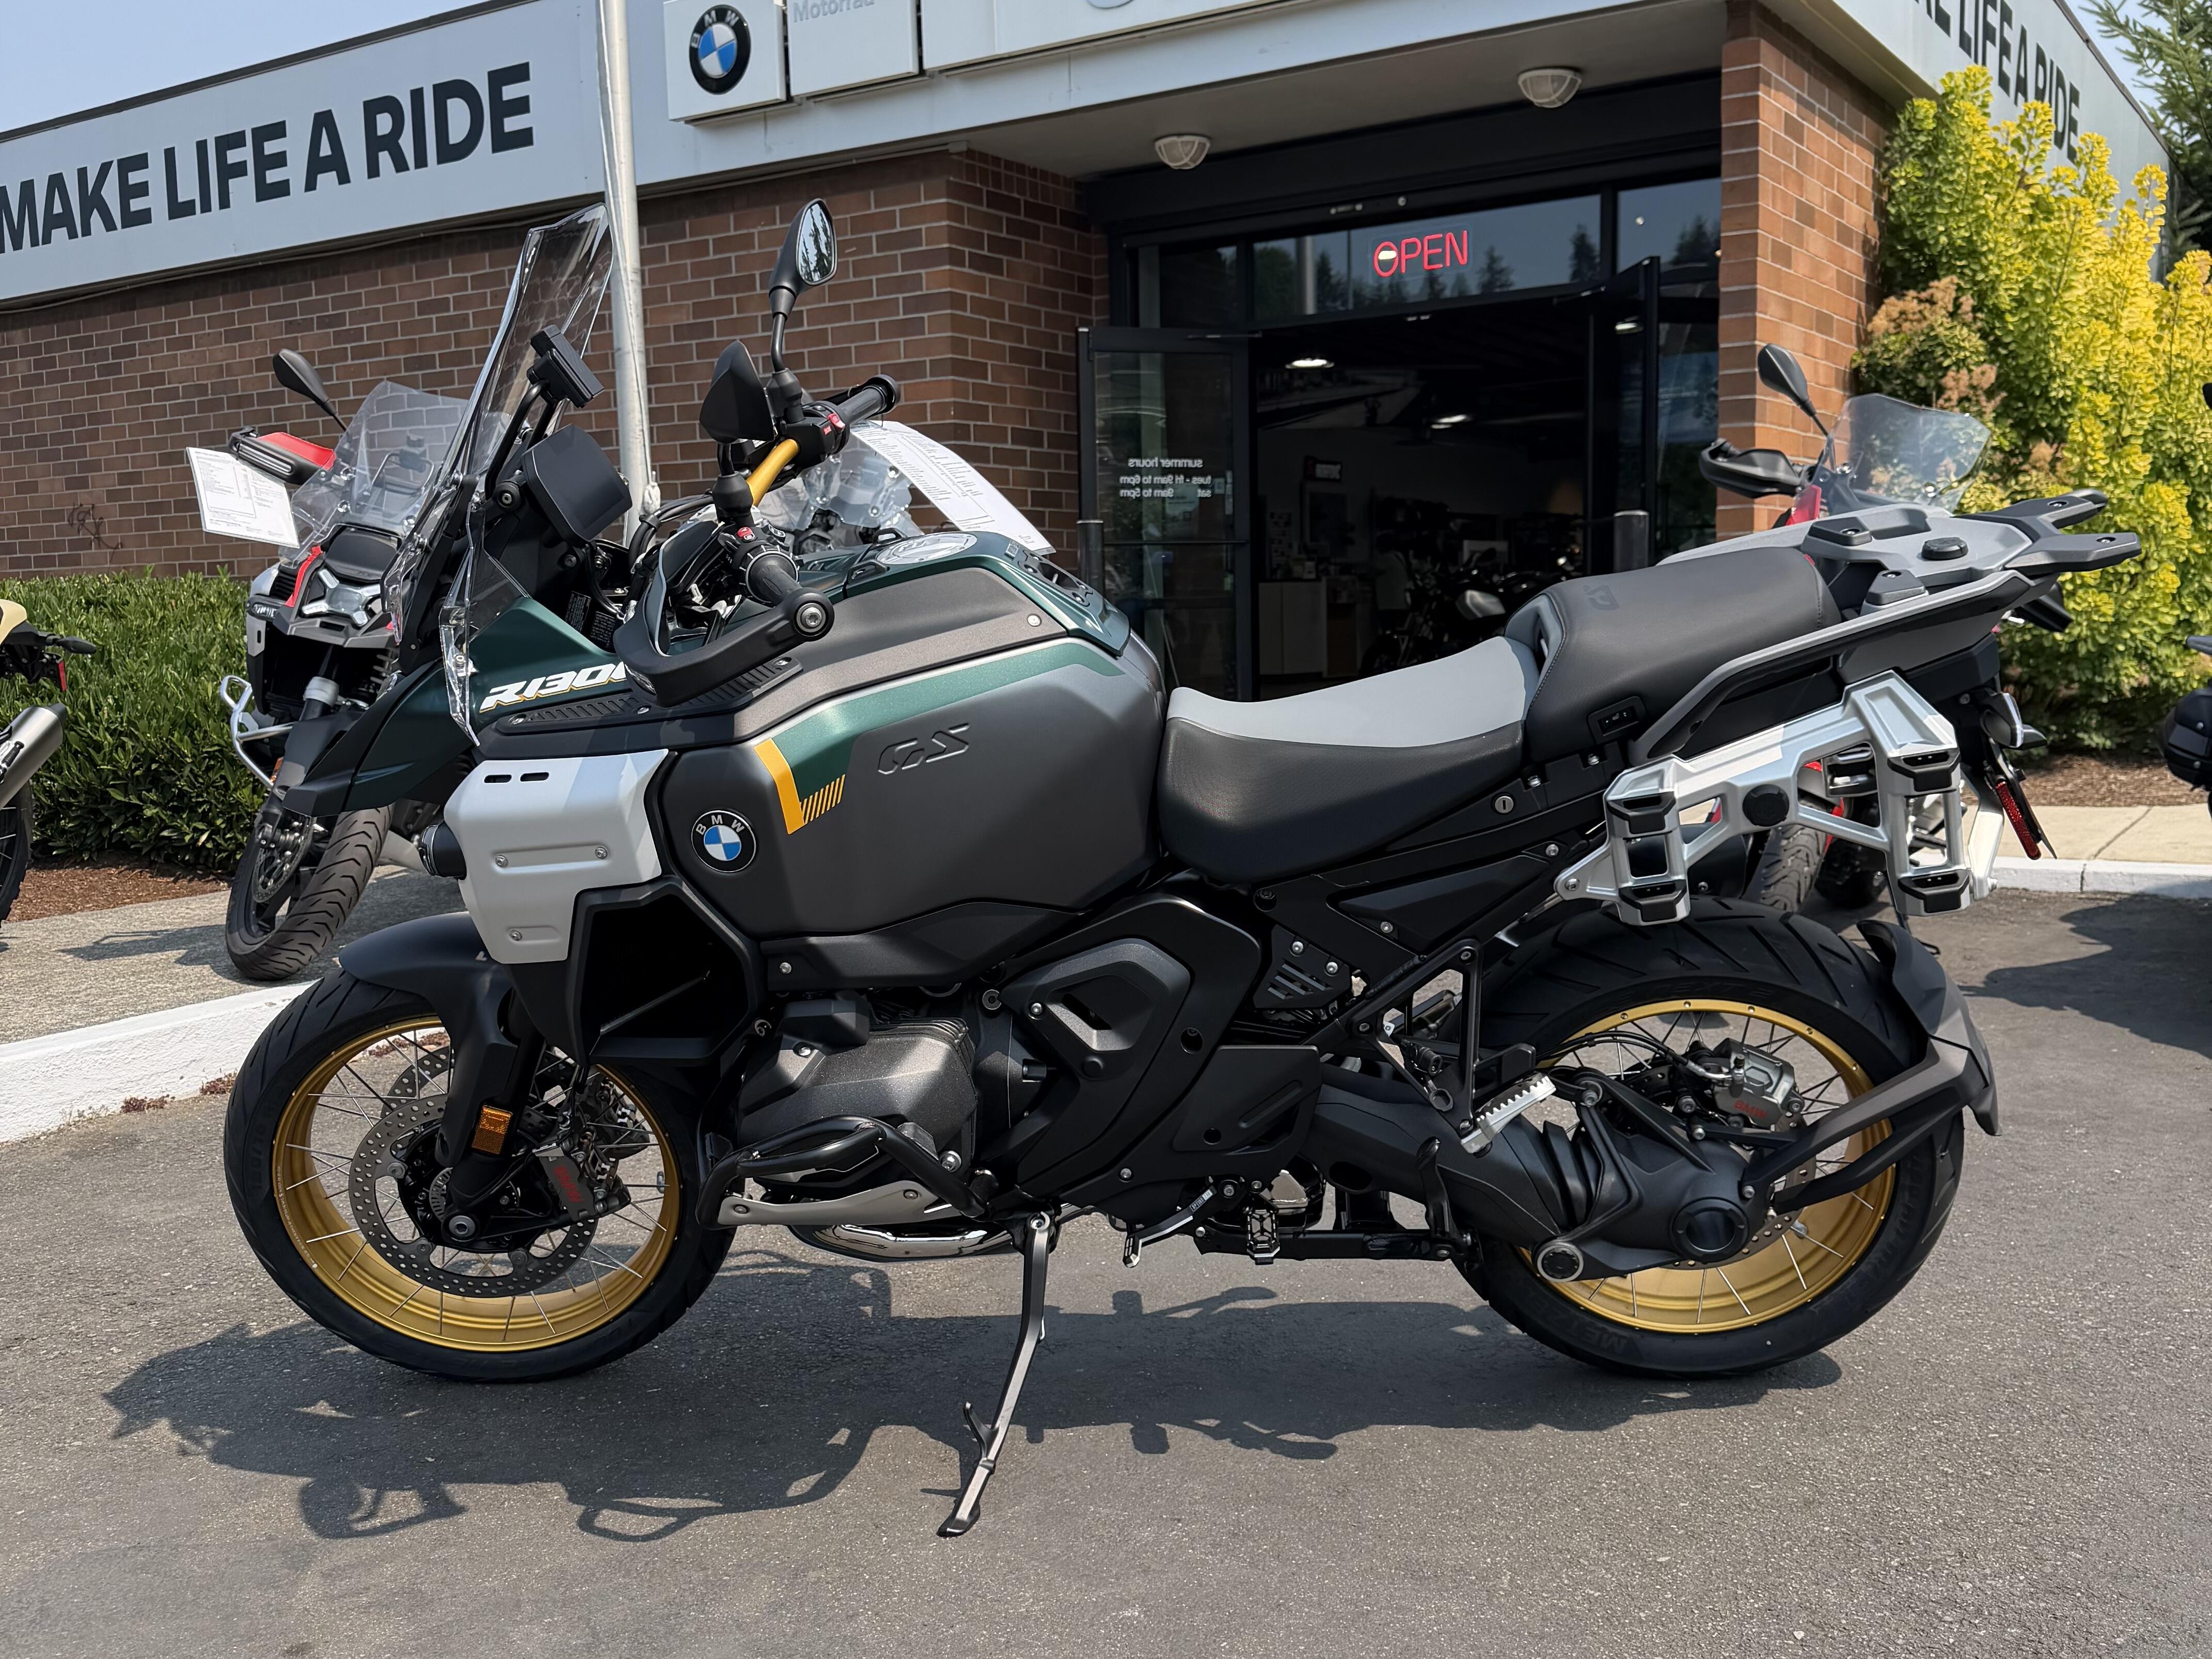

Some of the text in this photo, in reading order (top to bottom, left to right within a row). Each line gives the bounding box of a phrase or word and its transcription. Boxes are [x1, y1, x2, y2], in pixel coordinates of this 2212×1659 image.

[691, 10, 739, 48] BMW
[793, 0, 875, 22] Motorra
[2014, 24, 2028, 107] A
[0, 61, 534, 254] MAKE LIFE A RIDE
[1374, 230, 1468, 277] OPEN
[878, 723, 970, 775] GS
[696, 814, 745, 835] BMW
